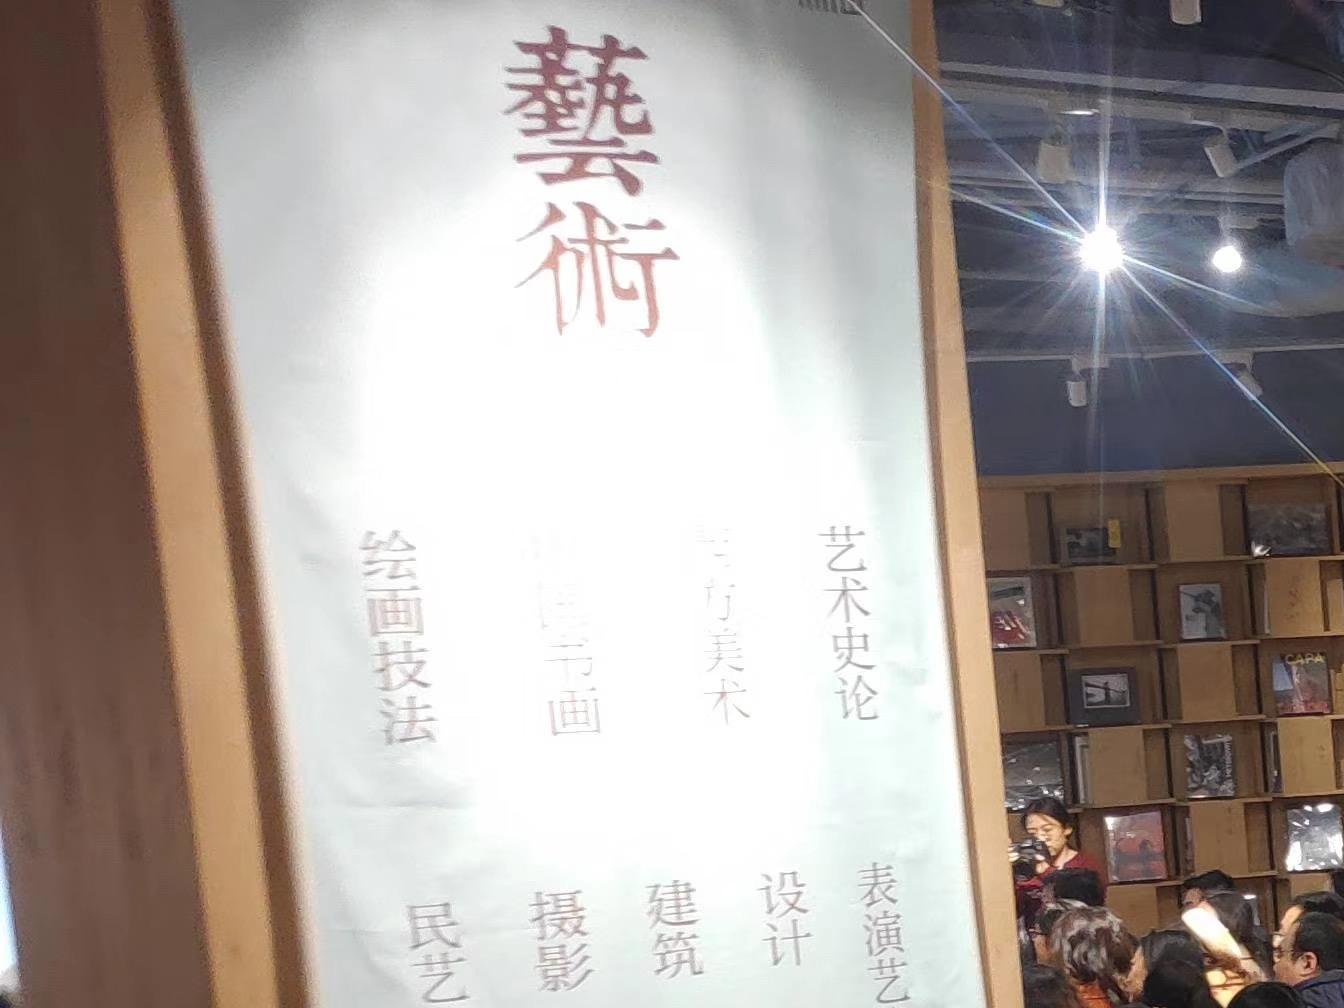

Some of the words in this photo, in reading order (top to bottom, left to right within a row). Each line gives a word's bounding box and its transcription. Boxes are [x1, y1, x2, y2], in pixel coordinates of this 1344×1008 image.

[503, 25, 680, 338] 藝術
[360, 528, 438, 745] 绘画技法
[816, 526, 880, 723] 艺术史论
[529, 888, 595, 994] 摄影
[646, 878, 706, 981] 建筑
[758, 871, 814, 968] 设计
